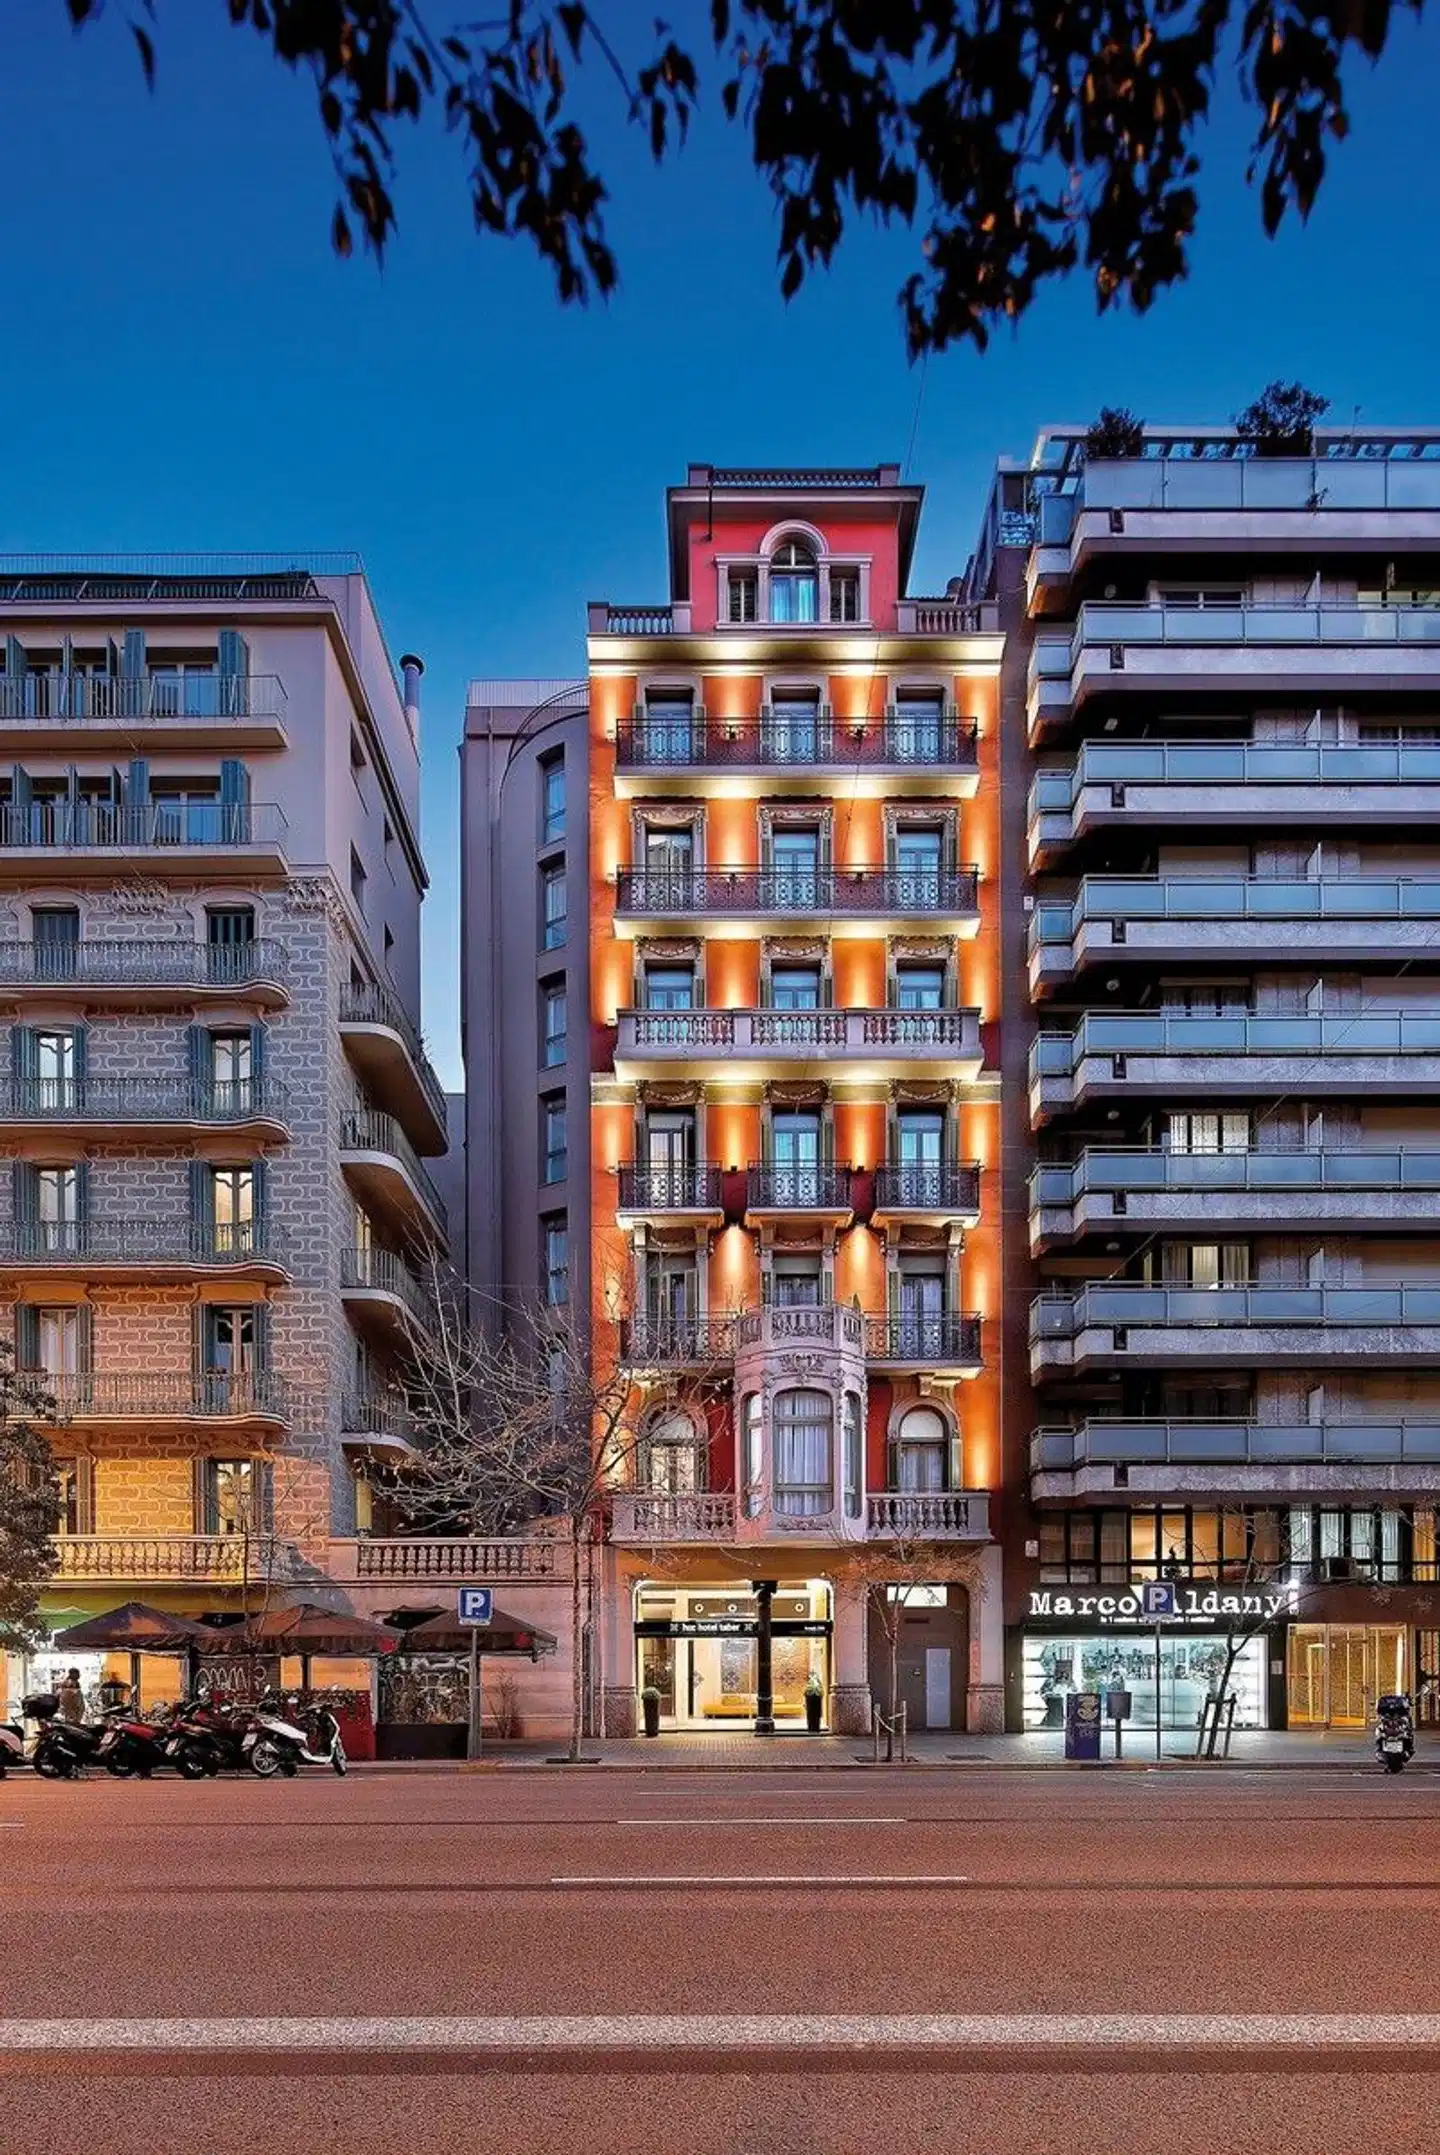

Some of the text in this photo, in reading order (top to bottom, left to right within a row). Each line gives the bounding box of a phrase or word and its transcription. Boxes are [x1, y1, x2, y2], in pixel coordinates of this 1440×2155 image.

[465, 1591, 485, 1616] P
[1028, 1592, 1138, 1616] Marco
[1149, 1587, 1169, 1612] P
[697, 1623, 718, 1631] hotel
